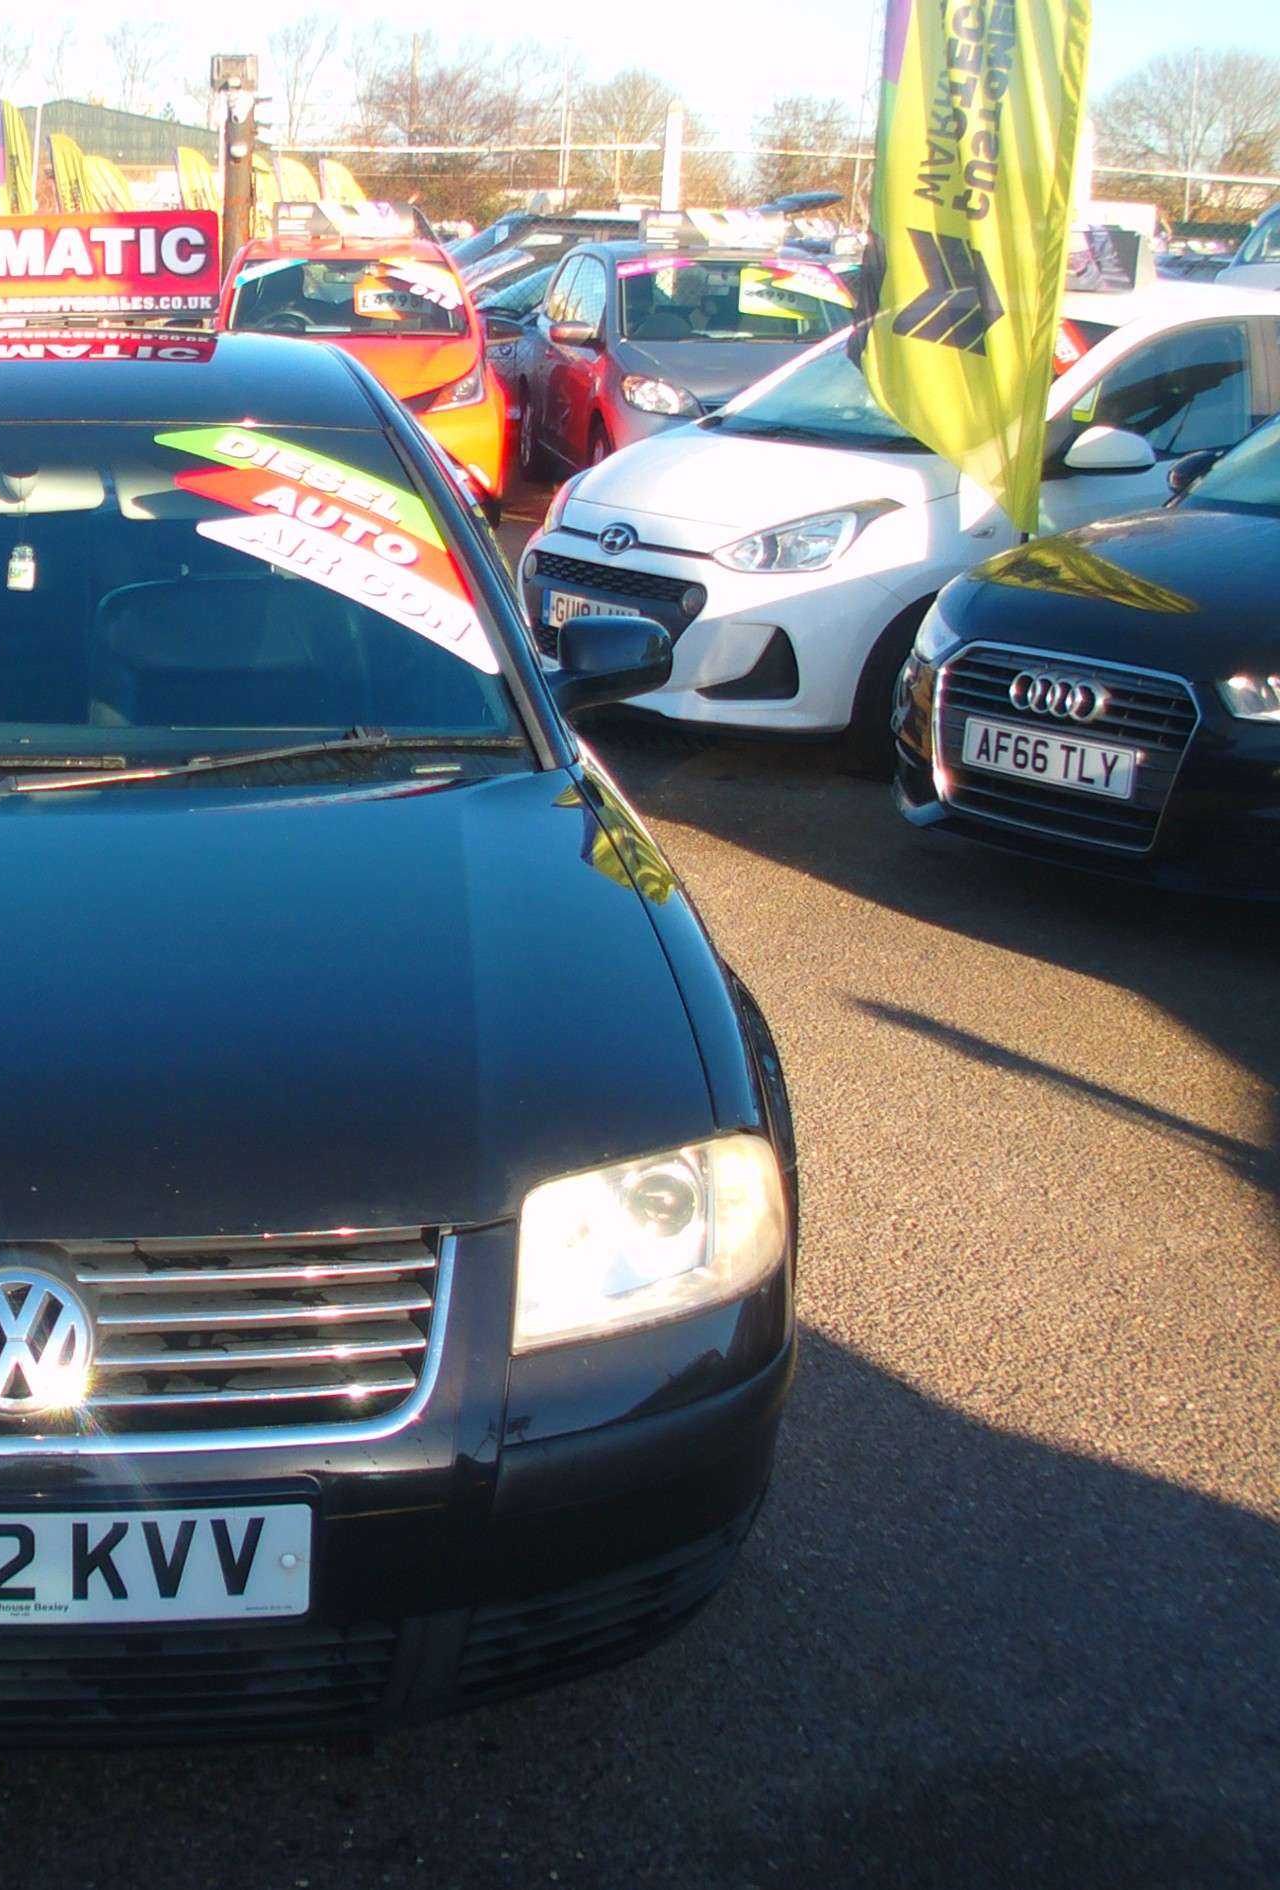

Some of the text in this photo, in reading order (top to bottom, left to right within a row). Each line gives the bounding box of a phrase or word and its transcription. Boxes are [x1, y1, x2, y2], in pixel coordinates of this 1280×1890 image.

[214, 435, 401, 524] DIESEL
[251, 485, 418, 565] AUTO
[238, 525, 472, 643] AIR CON
[976, 727, 1120, 789] AF66 TLY
[71, 1516, 266, 1601] KVV
